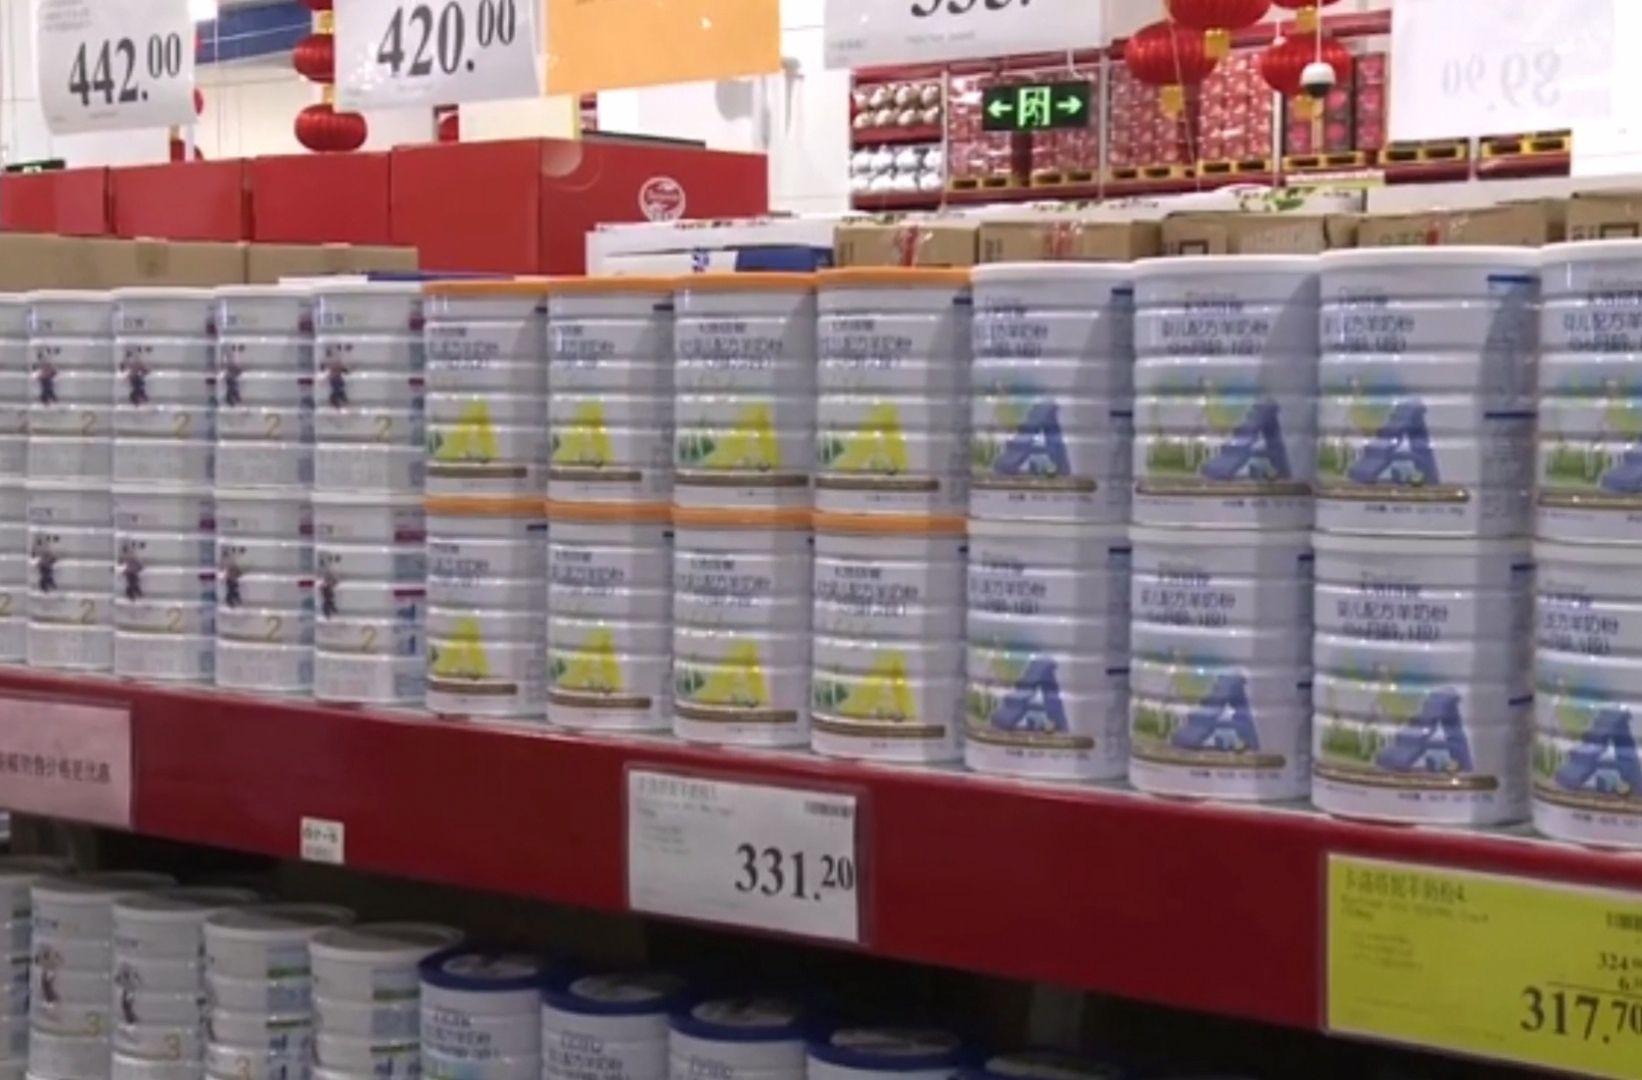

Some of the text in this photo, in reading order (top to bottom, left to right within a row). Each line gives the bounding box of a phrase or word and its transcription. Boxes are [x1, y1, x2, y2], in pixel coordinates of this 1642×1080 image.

[68, 32, 182, 107] 442.00
[377, 0, 516, 76] 420.00
[734, 842, 854, 902] 331.20
